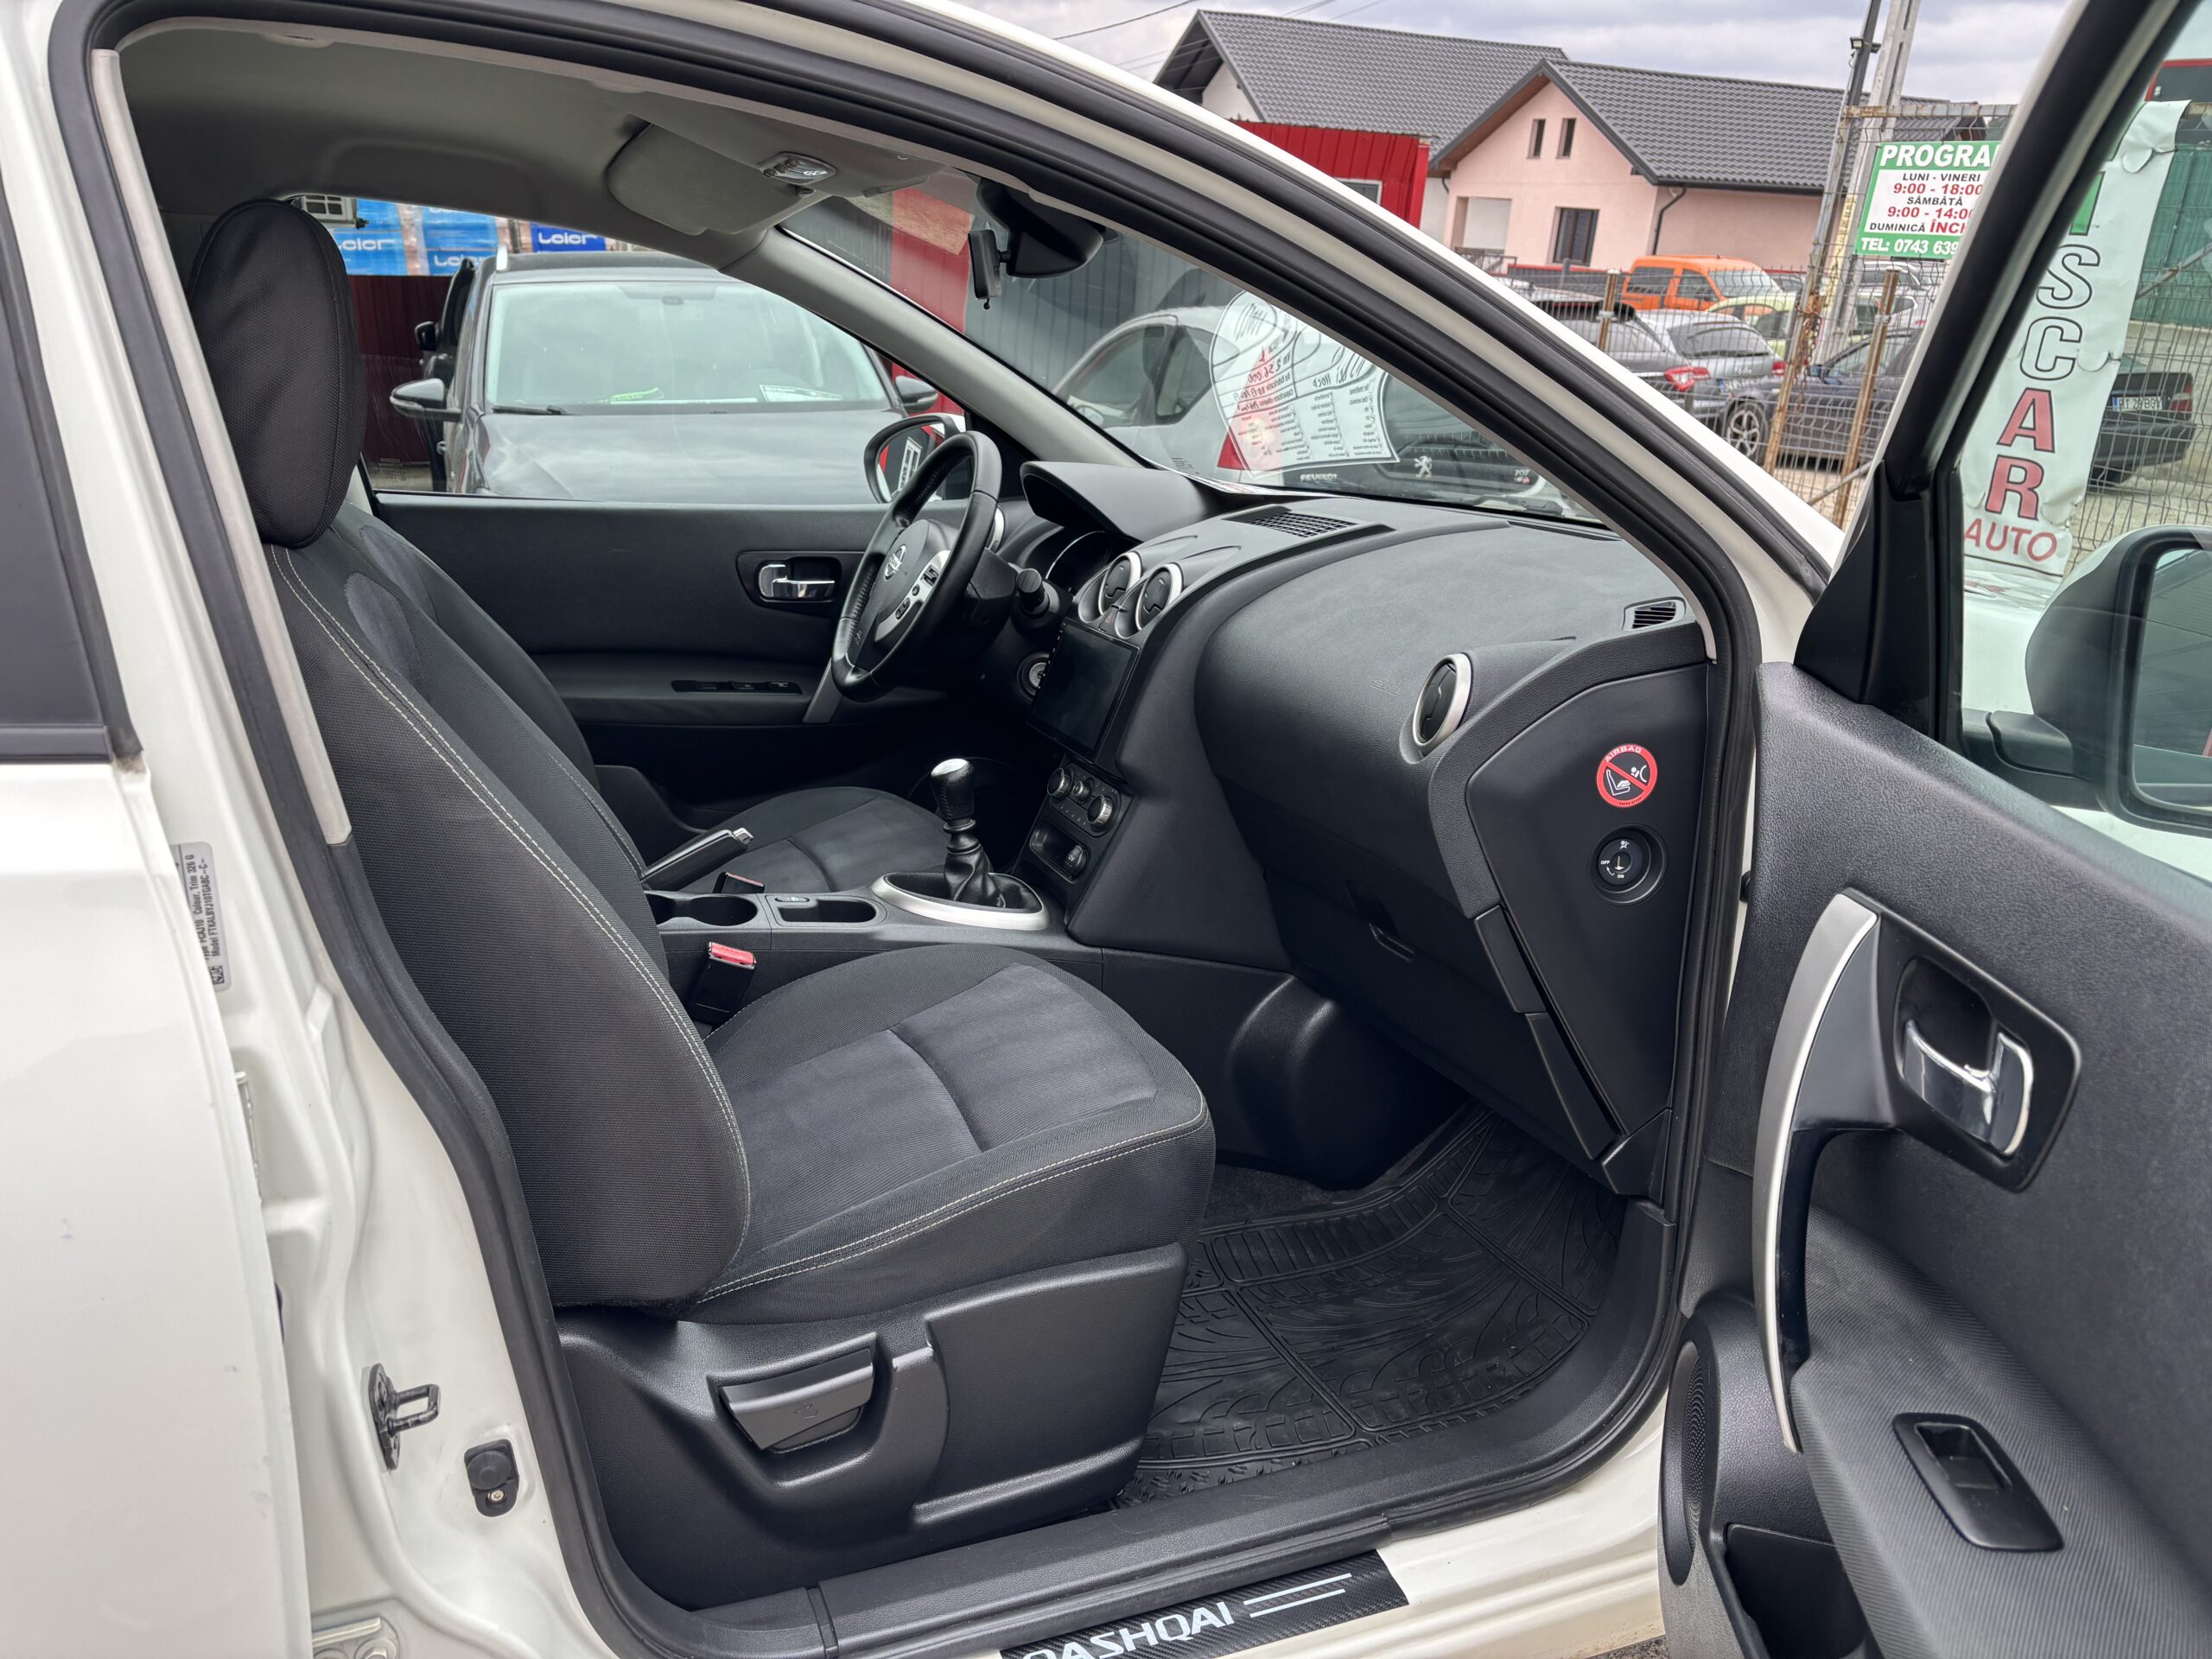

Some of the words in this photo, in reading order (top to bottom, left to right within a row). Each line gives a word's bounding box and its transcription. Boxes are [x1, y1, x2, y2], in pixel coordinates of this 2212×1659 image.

[1879, 144, 2000, 167] PROGRA
[1903, 173, 1929, 181] LUNI
[1941, 173, 1980, 182] VINERI
[1893, 183, 1926, 194] 9:00
[1941, 184, 1983, 195] 18:00
[1887, 207, 1920, 218] 9:00
[1869, 222, 1925, 232] DUMINICĂ
[1861, 238, 1890, 251] TEL:
[1894, 239, 1929, 252] 0743
[1964, 517, 2057, 562] AUTO
[1605, 746, 1643, 763] AIRBAG
[189, 875, 198, 891] Trim
[210, 937, 221, 957] Model
